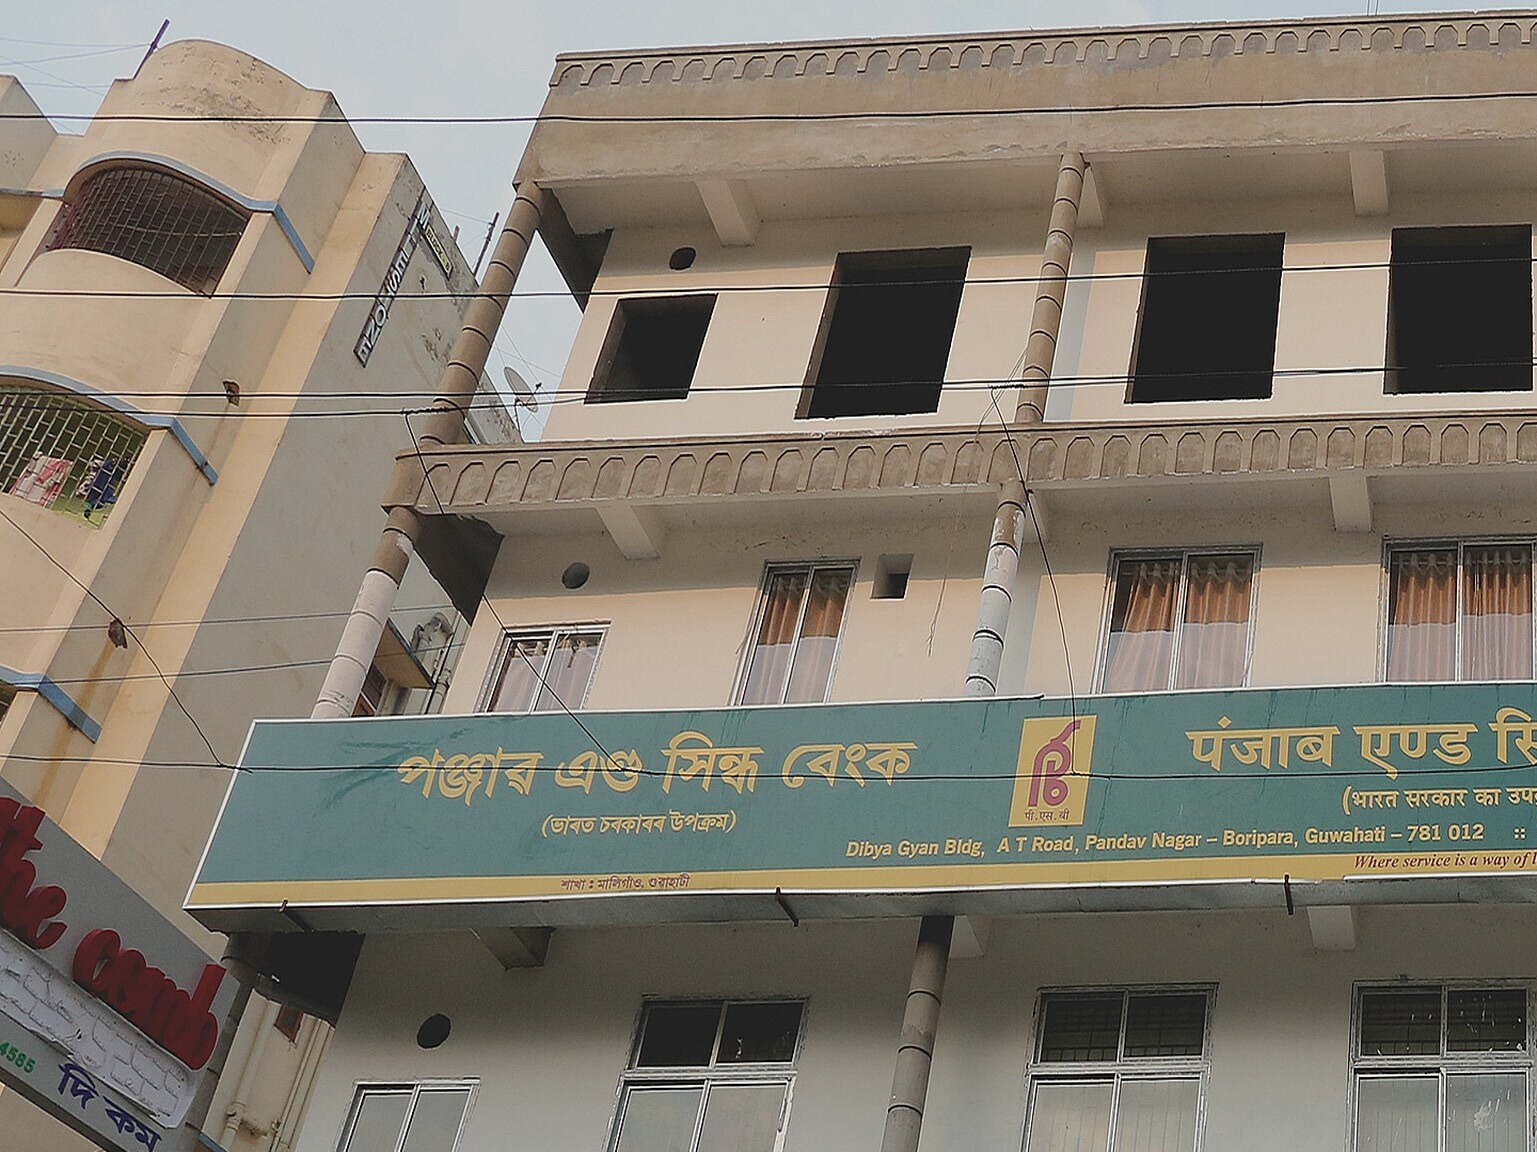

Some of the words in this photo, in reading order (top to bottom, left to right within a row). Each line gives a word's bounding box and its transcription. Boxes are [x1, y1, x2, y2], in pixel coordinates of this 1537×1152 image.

[781, 741, 918, 789] বেংক
[1185, 715, 1341, 772] पंजाब
[1353, 723, 1479, 780] एण्ड
[1342, 786, 1400, 815] (भारत
[1403, 788, 1468, 808] सरकार
[1473, 787, 1502, 806] का
[846, 841, 892, 860] Dibya
[897, 839, 939, 859] Gyan
[944, 838, 985, 858] Bldg,
[997, 837, 1011, 853] A
[1015, 836, 1027, 853] T
[1031, 835, 1079, 855] Road,
[1084, 833, 1147, 850] Pandav
[1152, 832, 1202, 851] Nagar
[1222, 828, 1300, 849] Boripara,
[1304, 826, 1386, 844] Guwahati
[1406, 825, 1441, 842] 781
[1448, 823, 1484, 841] 012
[1353, 854, 1400, 869] Where
[1402, 854, 1451, 868] service
[1454, 853, 1467, 866] is
[1469, 856, 1480, 867] a
[1482, 855, 1510, 870] way
[1513, 852, 1531, 870] of
[58, 1062, 100, 1110] দি
